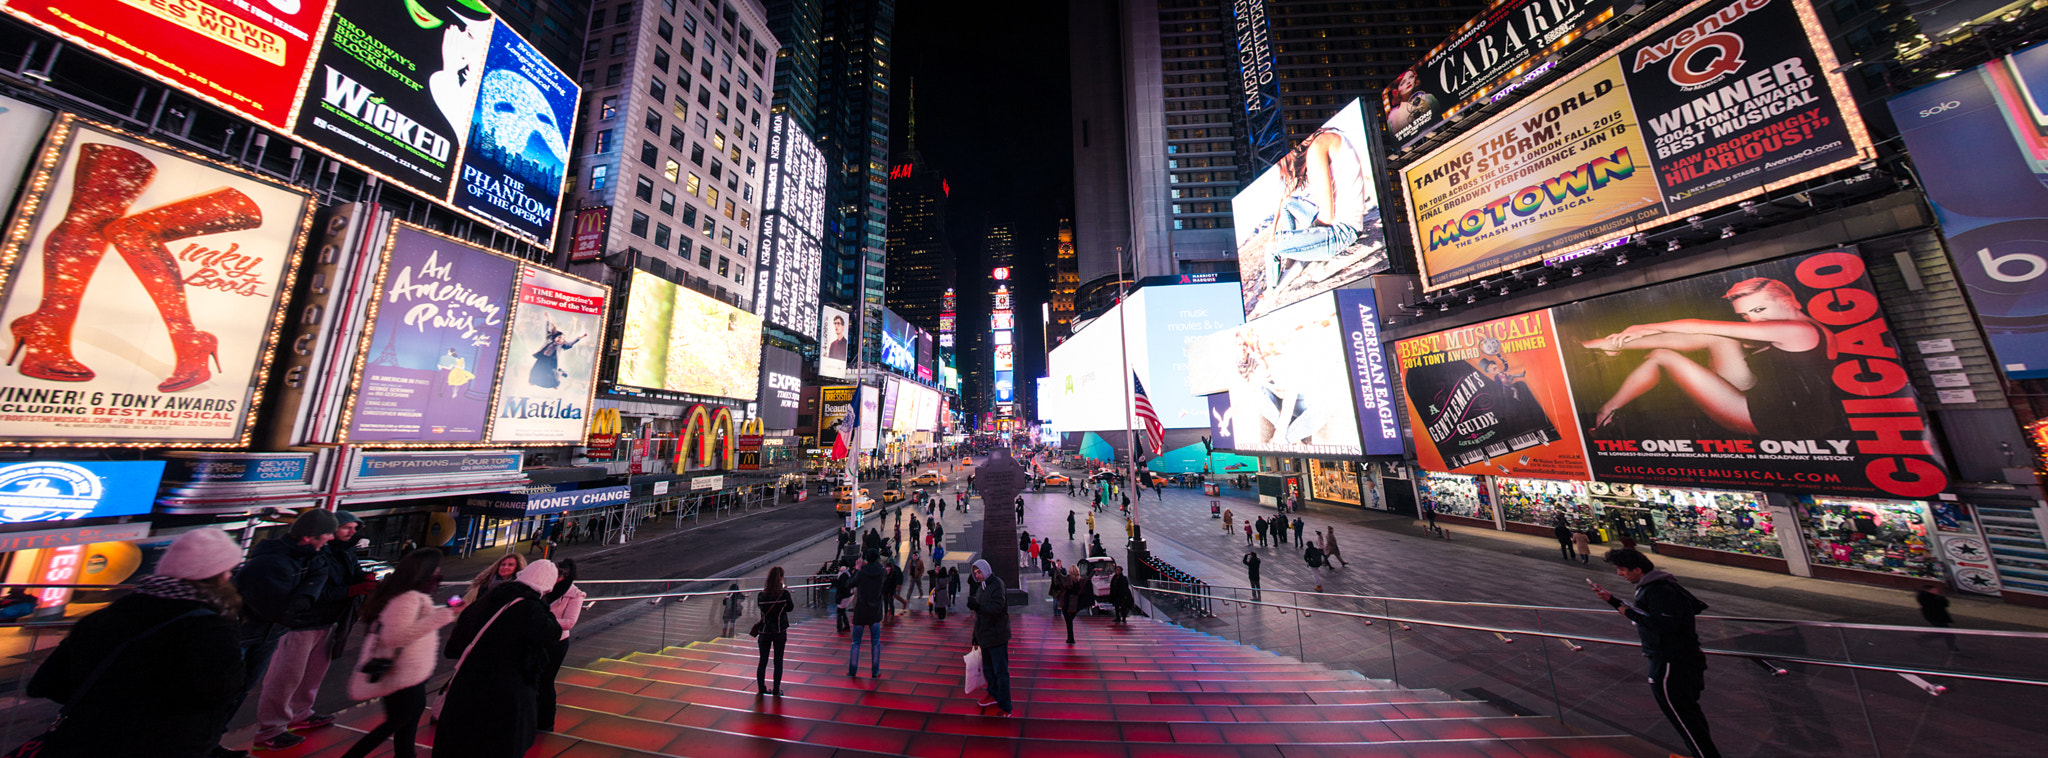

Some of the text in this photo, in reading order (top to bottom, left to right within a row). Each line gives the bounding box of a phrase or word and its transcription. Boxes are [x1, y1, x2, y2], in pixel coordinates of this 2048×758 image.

[181, 0, 275, 44] CROWD
[336, 25, 391, 63] BIGGEST
[1426, 20, 1488, 68] ALAN CUMMING
[1633, 0, 1772, 73] Avenue
[504, 42, 566, 96] Longest-Running
[518, 42, 558, 80] Broadway’s
[1439, 0, 1600, 95] CABARE
[1668, 32, 1747, 86] Q
[520, 64, 550, 92] Musical
[1240, 31, 1260, 111] AMERICAN
[1458, 47, 1529, 98] roundabouttheatre.org
[1647, 54, 1810, 139] WINNER
[1654, 76, 1814, 149] 2004 TONY AWARD
[1919, 100, 1960, 118] solo
[364, 124, 384, 137] STORY
[1413, 151, 1475, 190] TAKING
[1477, 128, 1519, 158] THE
[1521, 78, 1615, 134] WORLD
[1656, 87, 1819, 160] BEST MUSICAL
[1704, 107, 1823, 159] DROPPINGLY
[890, 163, 913, 180] H&M
[1418, 110, 1622, 212] ON TOUR ACROSS THE US LONDON FALL 2015
[1420, 123, 1626, 221] FINAL BROADWAY PERFORMANCE JAN 18
[1448, 121, 1564, 187] BY STORM!
[1690, 138, 1843, 194] NEW WORLD STAGES AvenueQ.com
[464, 164, 552, 222] PHANTOM
[503, 174, 525, 191] THE
[766, 162, 778, 210] EXPRESS
[1424, 146, 1634, 252] MOTOWN
[468, 183, 485, 198] OF
[488, 190, 509, 210] THE
[510, 204, 542, 227] OPERA
[1455, 195, 1595, 250] THE SMASH HITS MUSICAL
[1552, 206, 1659, 248] MOTOWNTHEMUSICAL.COM
[179, 243, 263, 277] inky
[418, 250, 452, 281] An
[580, 240, 594, 251] 24
[184, 268, 268, 298] Boots
[284, 215, 347, 388] PALACE
[389, 266, 500, 326] American
[524, 294, 598, 314] #1 Show of the Year!
[532, 286, 594, 306] TIME Magazine’s
[404, 303, 478, 340] Paris
[1400, 314, 1543, 362] BEST MUSICAL!
[1352, 331, 1376, 409] OUTFITTERS
[1358, 304, 1396, 438] AMERICAN EAGLE
[1402, 336, 1546, 370] 2014 TONY AWARD WINNER
[1795, 252, 1947, 497] CHICAGO
[0, 404, 232, 420] CLUDING BEST MUSICAL
[91, 392, 237, 412] 6 TONY AWARDS
[502, 396, 583, 420] Matilda
[1428, 402, 1440, 416] A
[1429, 370, 1486, 444] GENTLEMAN’S
[1456, 411, 1498, 436] GUIDE
[366, 460, 449, 470] TEMPTATIONS
[1595, 440, 1850, 454] THE ONE THE ONLY
[1614, 466, 1841, 483] CHICAGOTHEMUSICAL.COM
[494, 501, 527, 510] CHANGE
[526, 490, 631, 511] MONEY CHANGE
